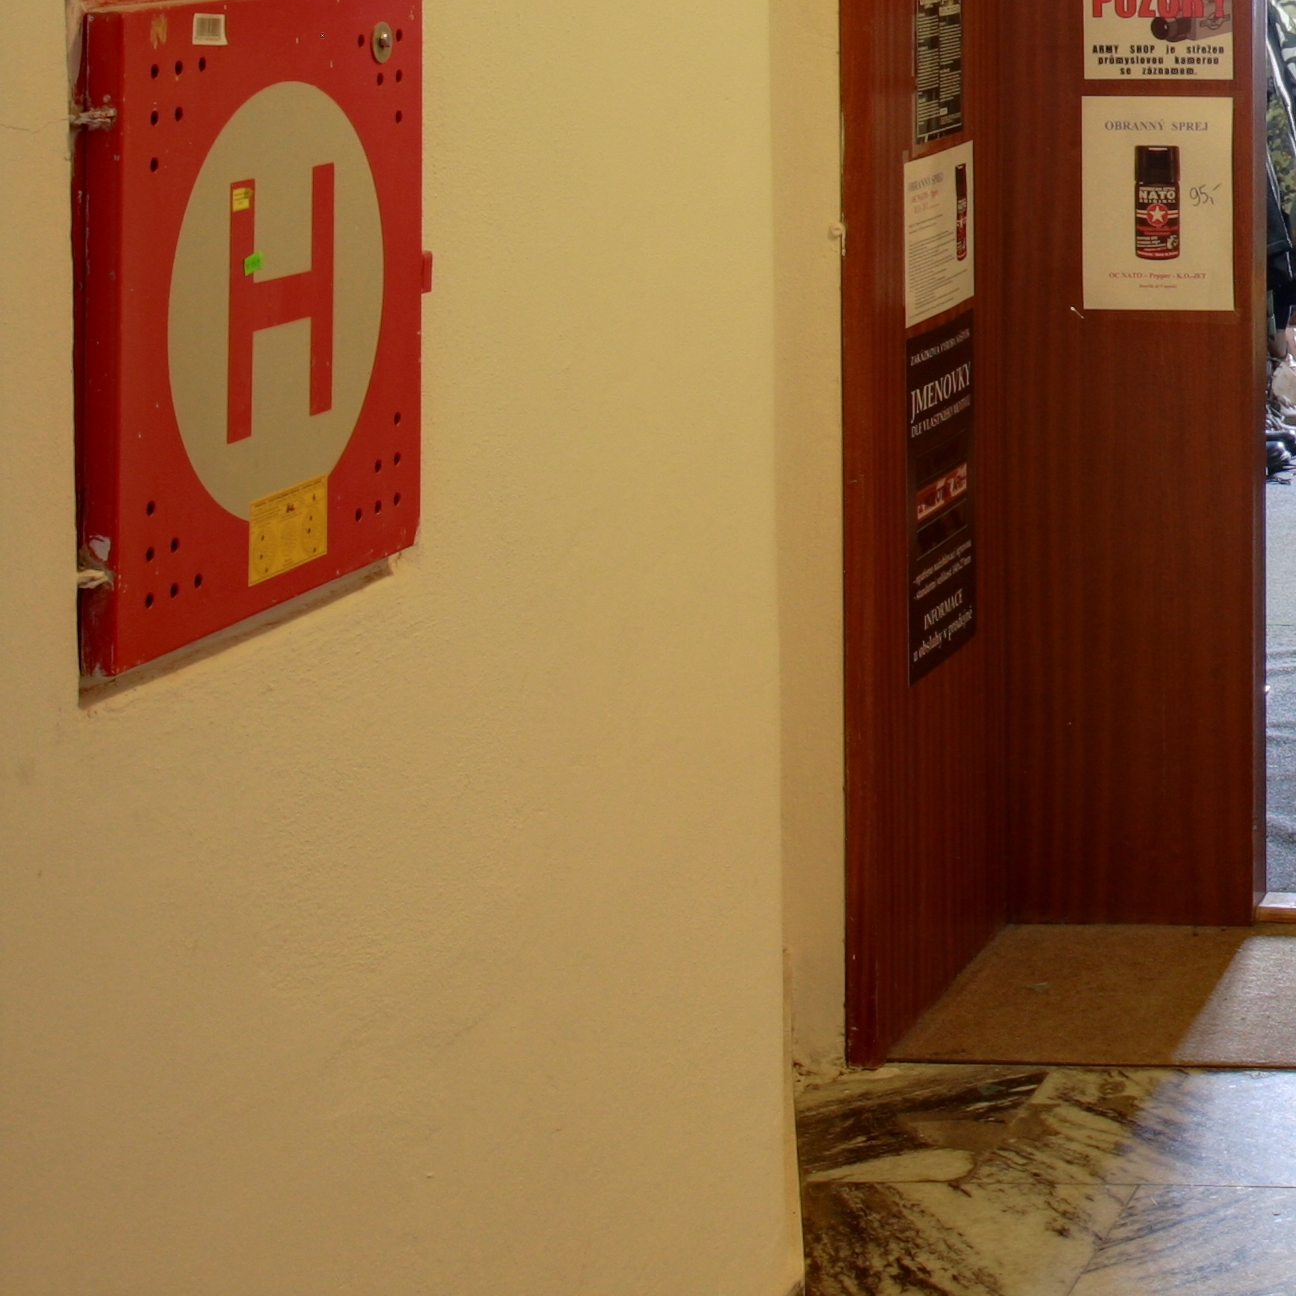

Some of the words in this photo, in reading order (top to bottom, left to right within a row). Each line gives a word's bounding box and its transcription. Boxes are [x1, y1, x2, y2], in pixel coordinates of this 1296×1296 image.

[1092, 44, 1119, 53] ARMY
[1129, 44, 1156, 53] SHOP
[1165, 44, 1176, 54] je
[1174, 55, 1219, 64] kamerou
[1171, 121, 1209, 132] SPREJ
[1139, 190, 1176, 199] NATO
[227, 162, 335, 445] H
[910, 361, 971, 424] JMENOVKY
